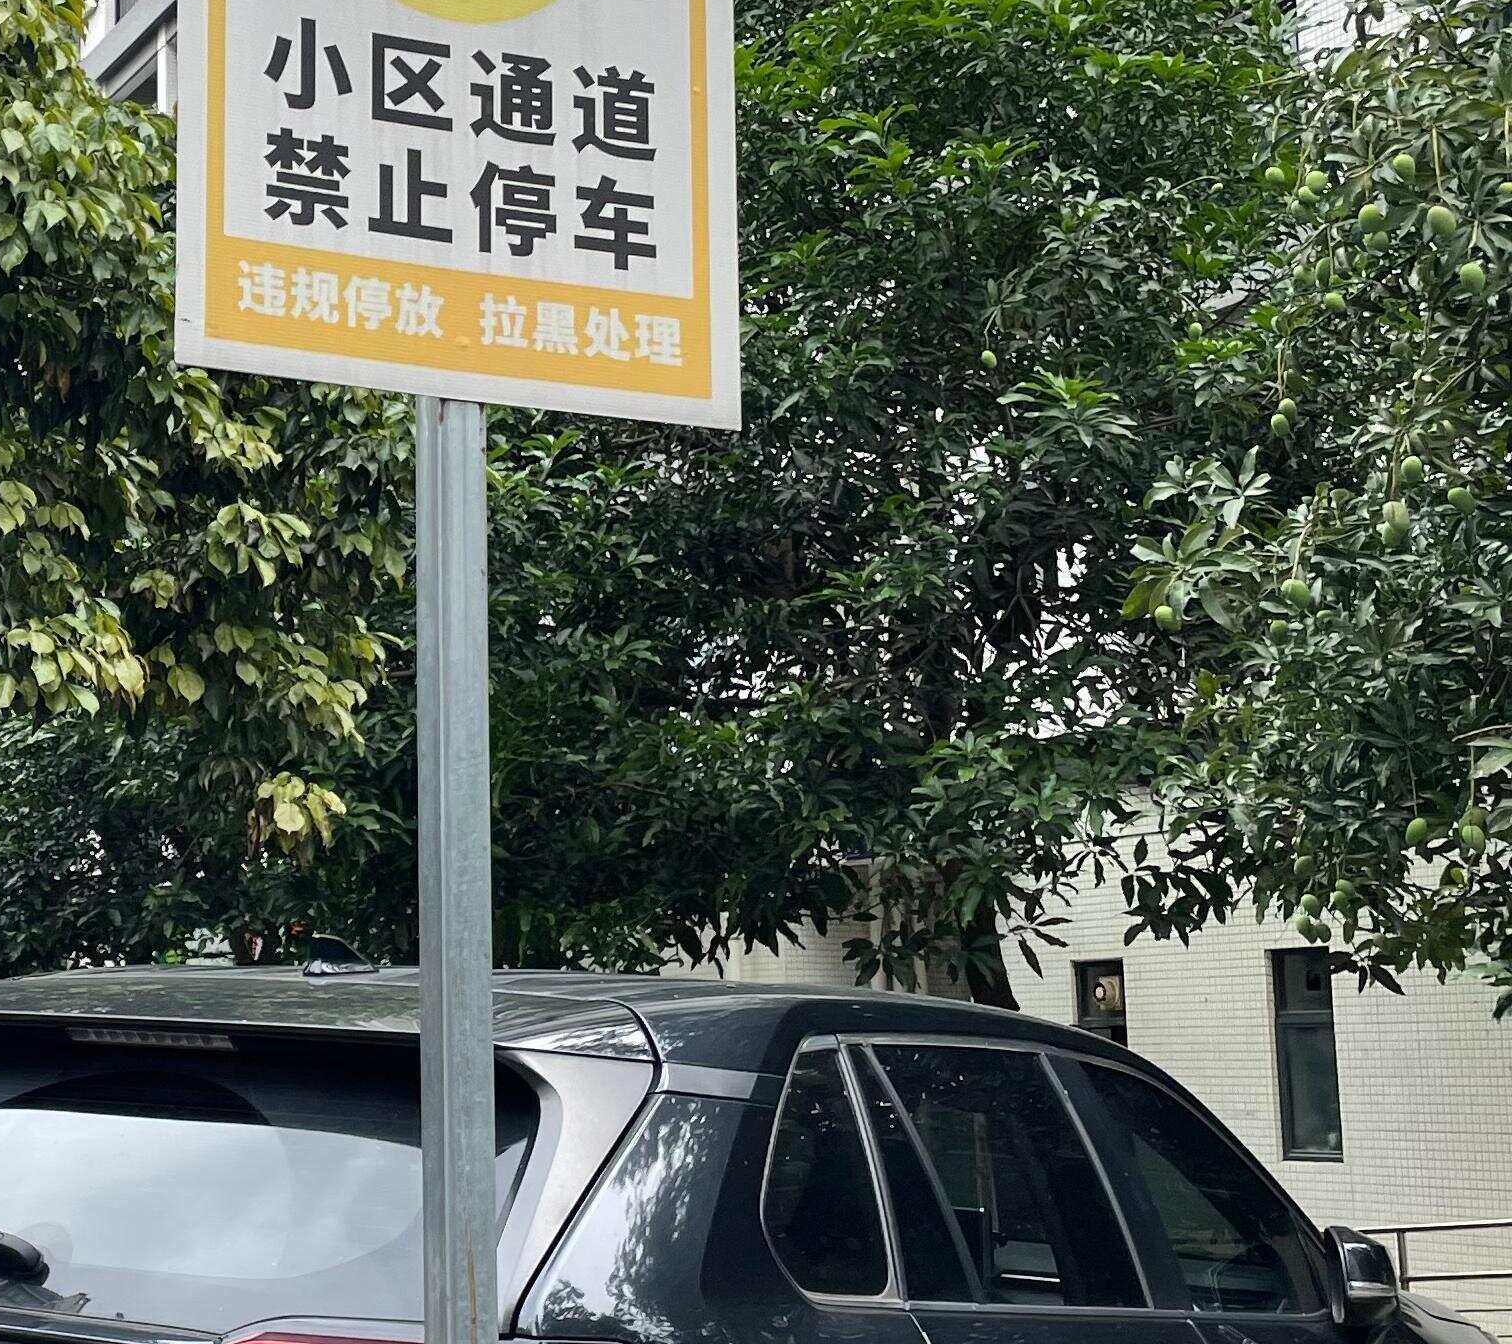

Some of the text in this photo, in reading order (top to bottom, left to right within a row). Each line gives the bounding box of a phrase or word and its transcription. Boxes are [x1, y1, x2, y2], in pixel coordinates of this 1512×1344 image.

[264, 17, 657, 163] 小区通道
[264, 127, 657, 271] 禁止停车
[237, 259, 684, 368] 违规停放 拉黑处理
